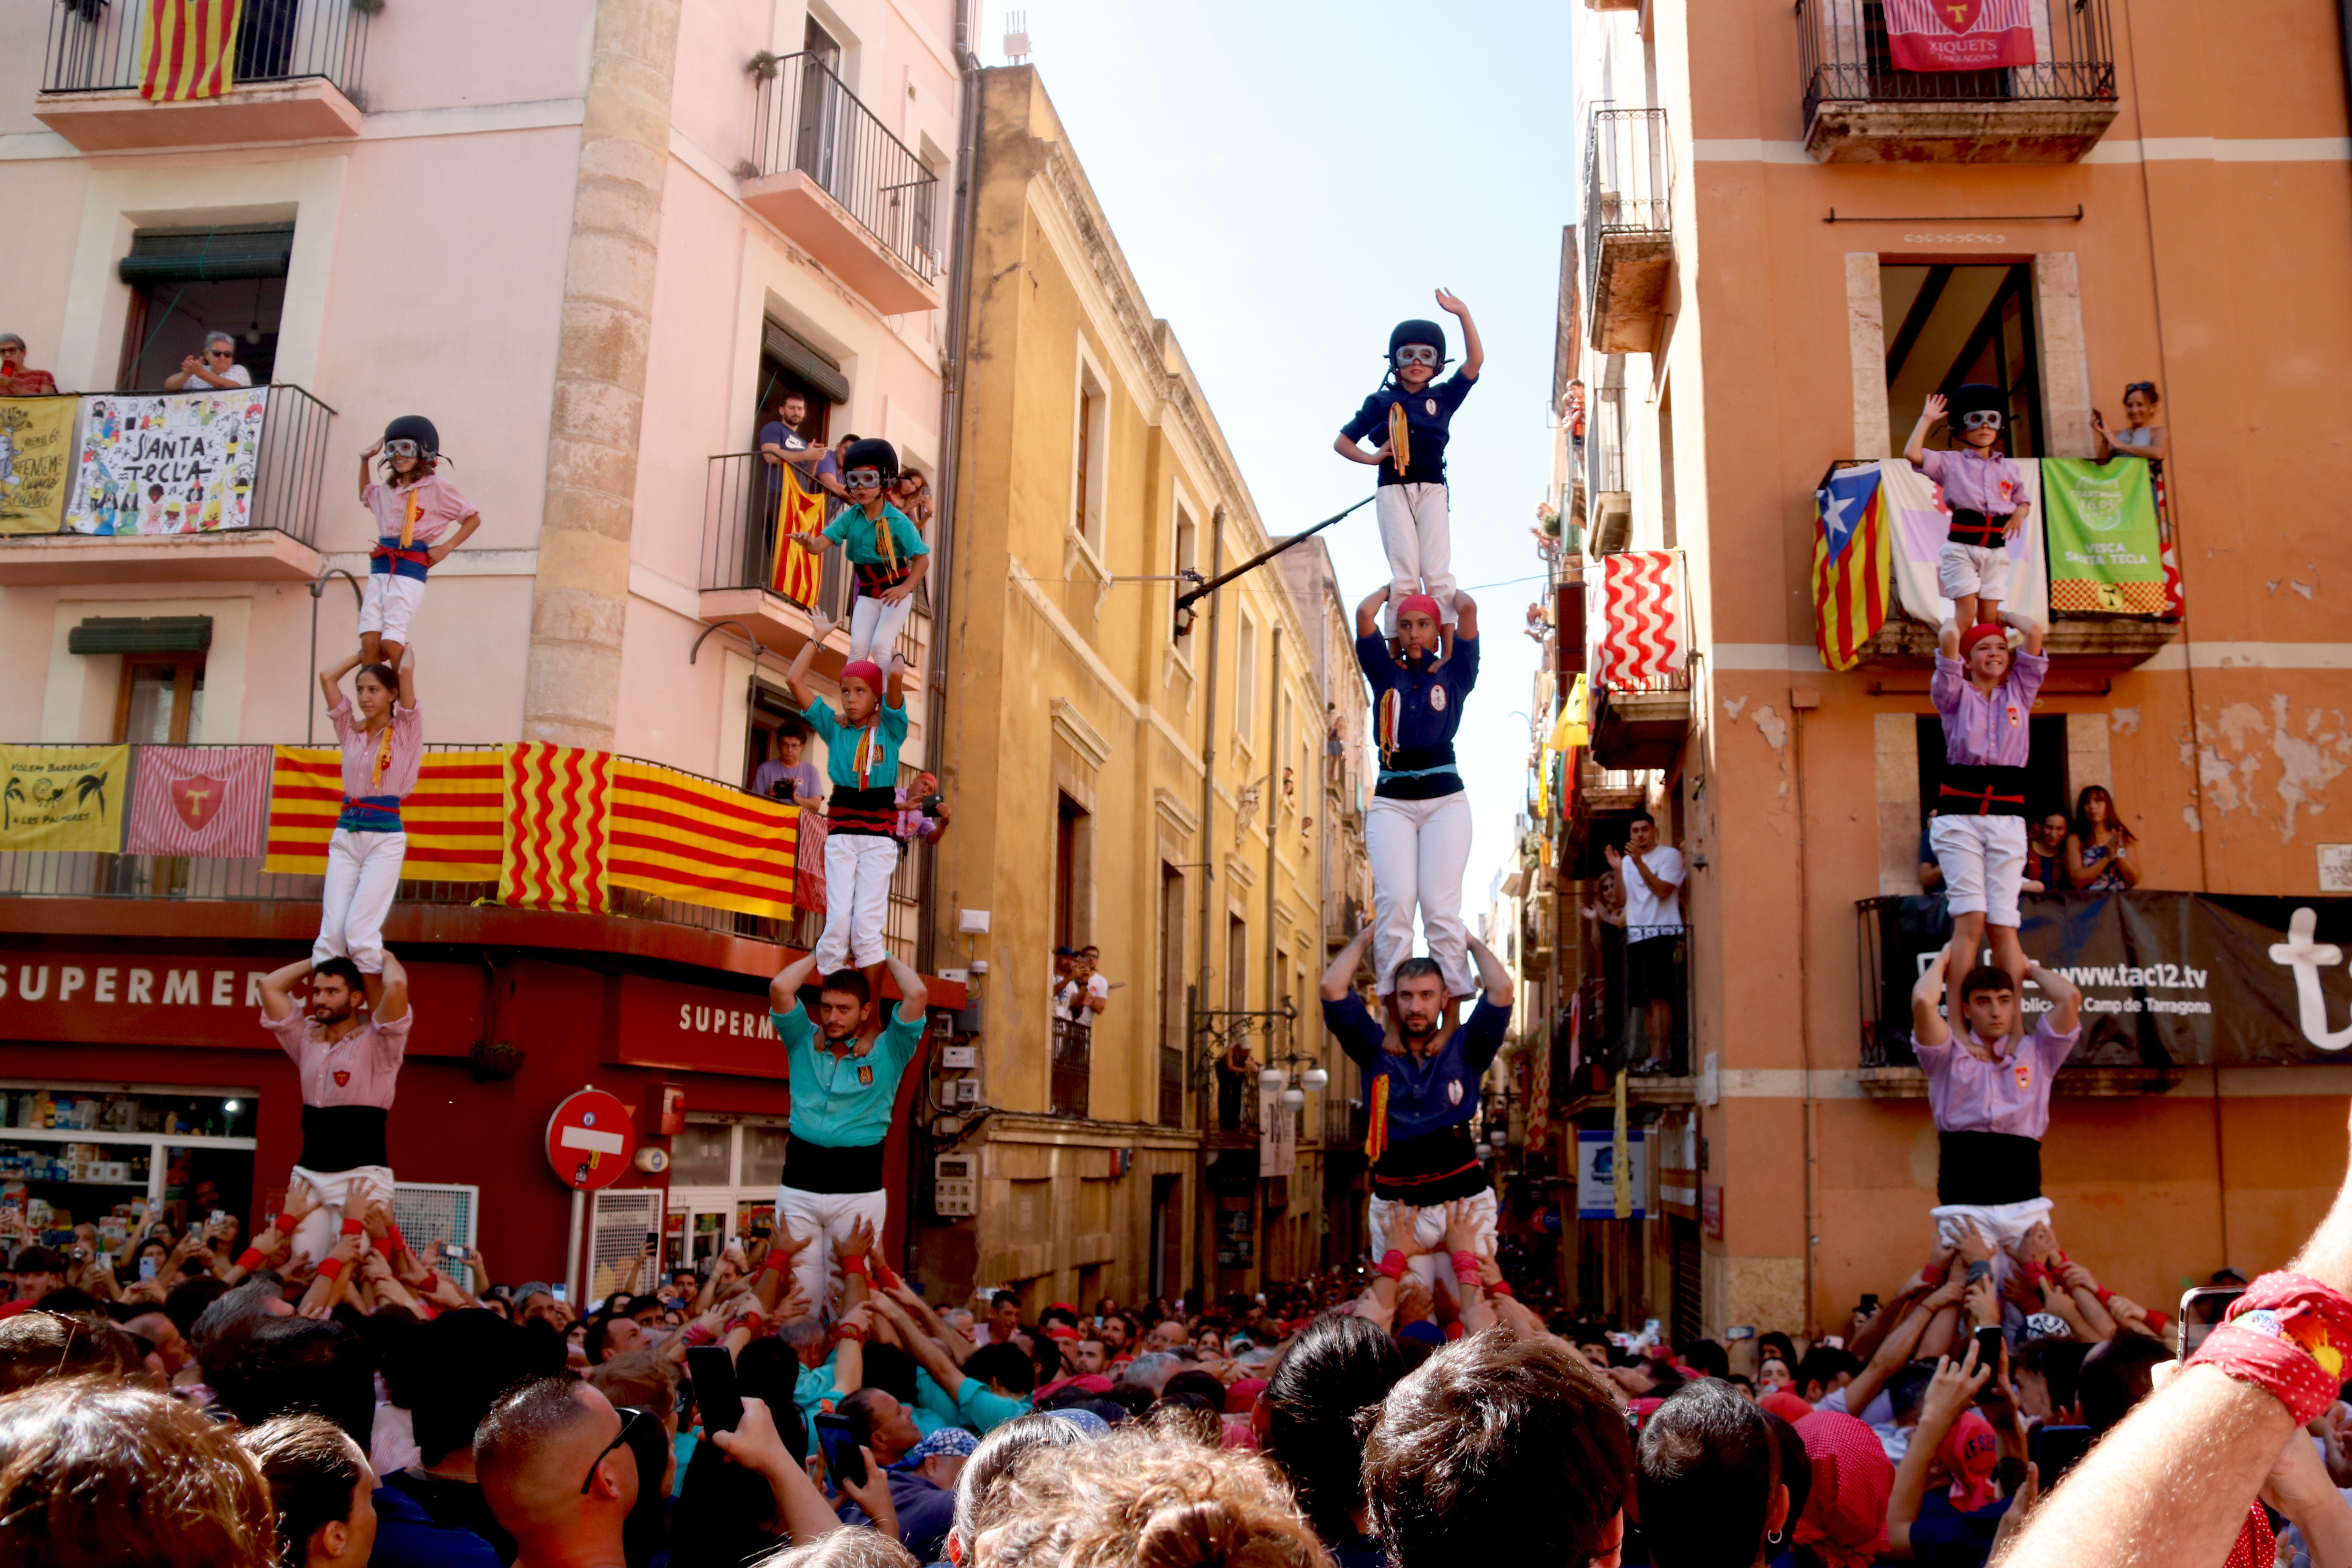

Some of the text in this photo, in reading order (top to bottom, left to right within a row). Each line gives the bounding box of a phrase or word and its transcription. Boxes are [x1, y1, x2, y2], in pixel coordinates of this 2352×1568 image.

[1928, 39, 1997, 55] XIQUETS
[132, 433, 205, 461] SANTA
[2085, 542, 2126, 553] VISCA
[2065, 551, 2148, 565] SANTA TECLA
[12, 761, 101, 771] VOLEM BARRAQUES
[42, 813, 90, 824] PALMERES
[2083, 997, 2122, 1014] Camp
[2123, 998, 2143, 1012] de
[2144, 997, 2212, 1015] Tarragona
[679, 1003, 781, 1041] SUPERM
